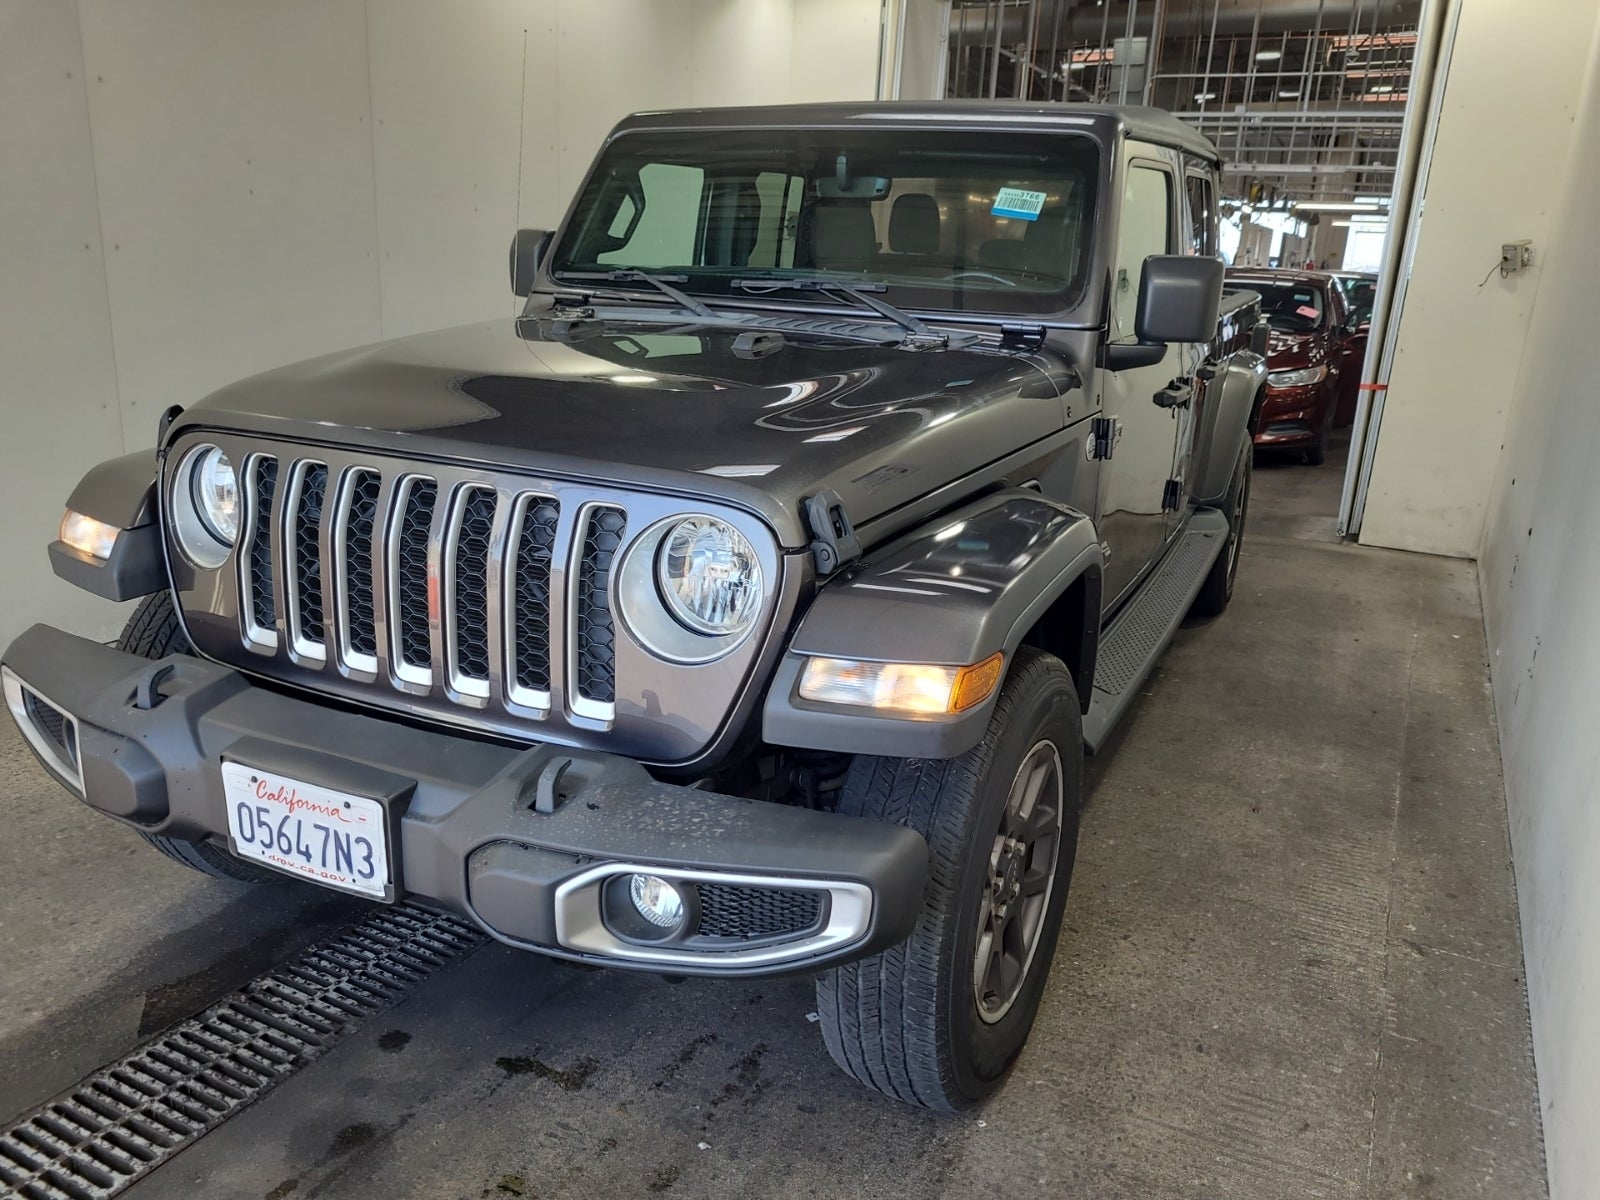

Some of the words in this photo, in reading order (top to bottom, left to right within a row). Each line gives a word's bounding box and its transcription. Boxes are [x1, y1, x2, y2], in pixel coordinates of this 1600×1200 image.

[256, 780, 352, 823] California
[237, 802, 375, 880] 05647N3
[268, 854, 346, 883] dmv.ca.gov
